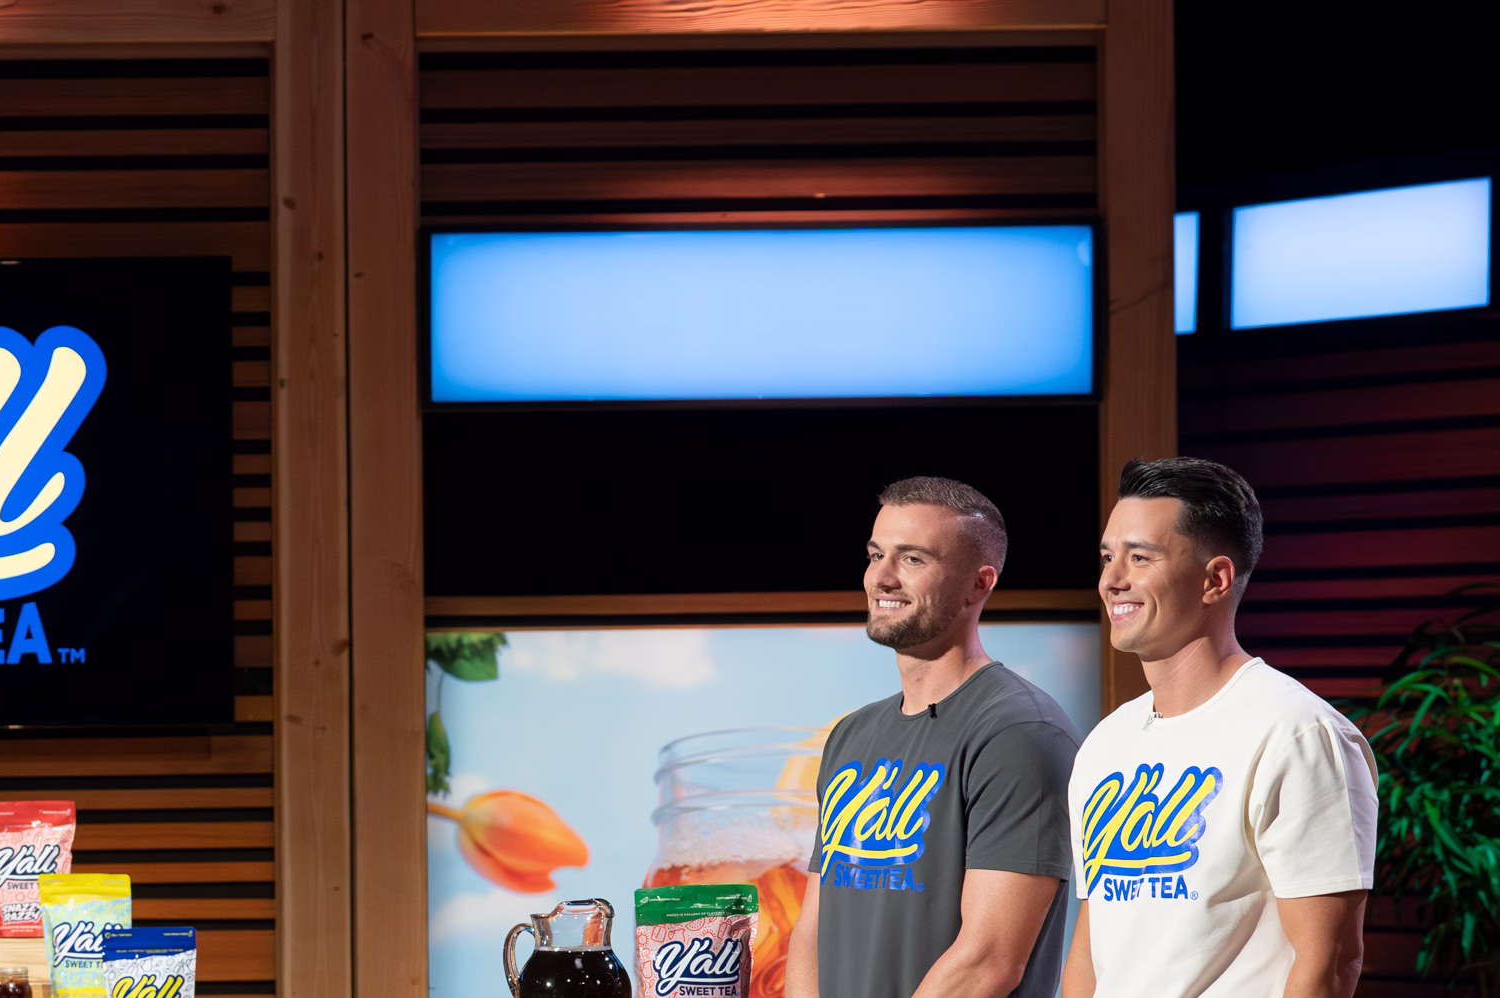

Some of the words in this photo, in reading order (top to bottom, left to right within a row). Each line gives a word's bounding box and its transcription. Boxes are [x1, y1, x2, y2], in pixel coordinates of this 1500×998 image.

[821, 760, 944, 882] Y'all
[1083, 764, 1222, 895] Y'all
[65, 960, 92, 968] SWEET
[653, 938, 742, 996] Y'all
[679, 987, 716, 996] SWEET
[719, 986, 737, 996] TEA
